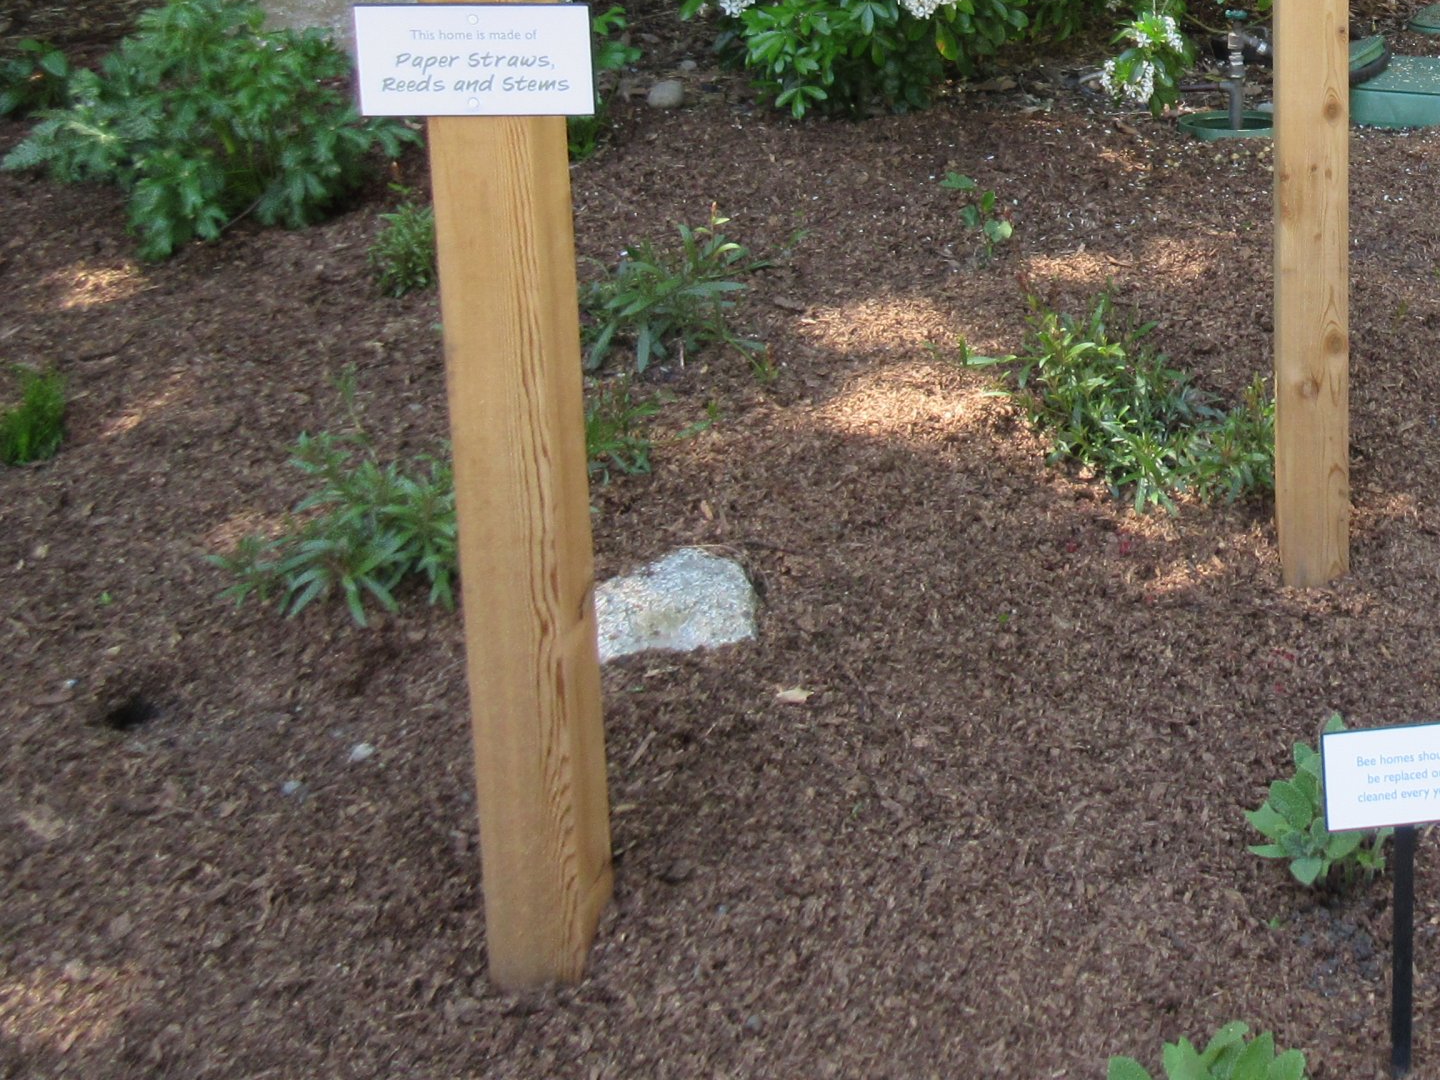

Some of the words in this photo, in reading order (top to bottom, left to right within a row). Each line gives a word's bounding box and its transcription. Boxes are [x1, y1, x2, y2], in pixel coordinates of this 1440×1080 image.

[410, 29, 435, 41] This
[439, 30, 472, 41] home
[477, 30, 485, 40] is
[489, 30, 521, 40] made
[525, 29, 537, 40] of
[395, 53, 460, 75] Paper
[468, 52, 555, 70] Straws,
[382, 75, 445, 92] Reeds
[454, 74, 494, 92] and
[502, 76, 570, 92] Stems
[1357, 756, 1376, 767] Bee
[1380, 754, 1414, 765] homes
[1368, 774, 1380, 784] be
[1384, 769, 1428, 784] replaced
[1358, 790, 1397, 803] cleaned
[1401, 788, 1430, 800] every
